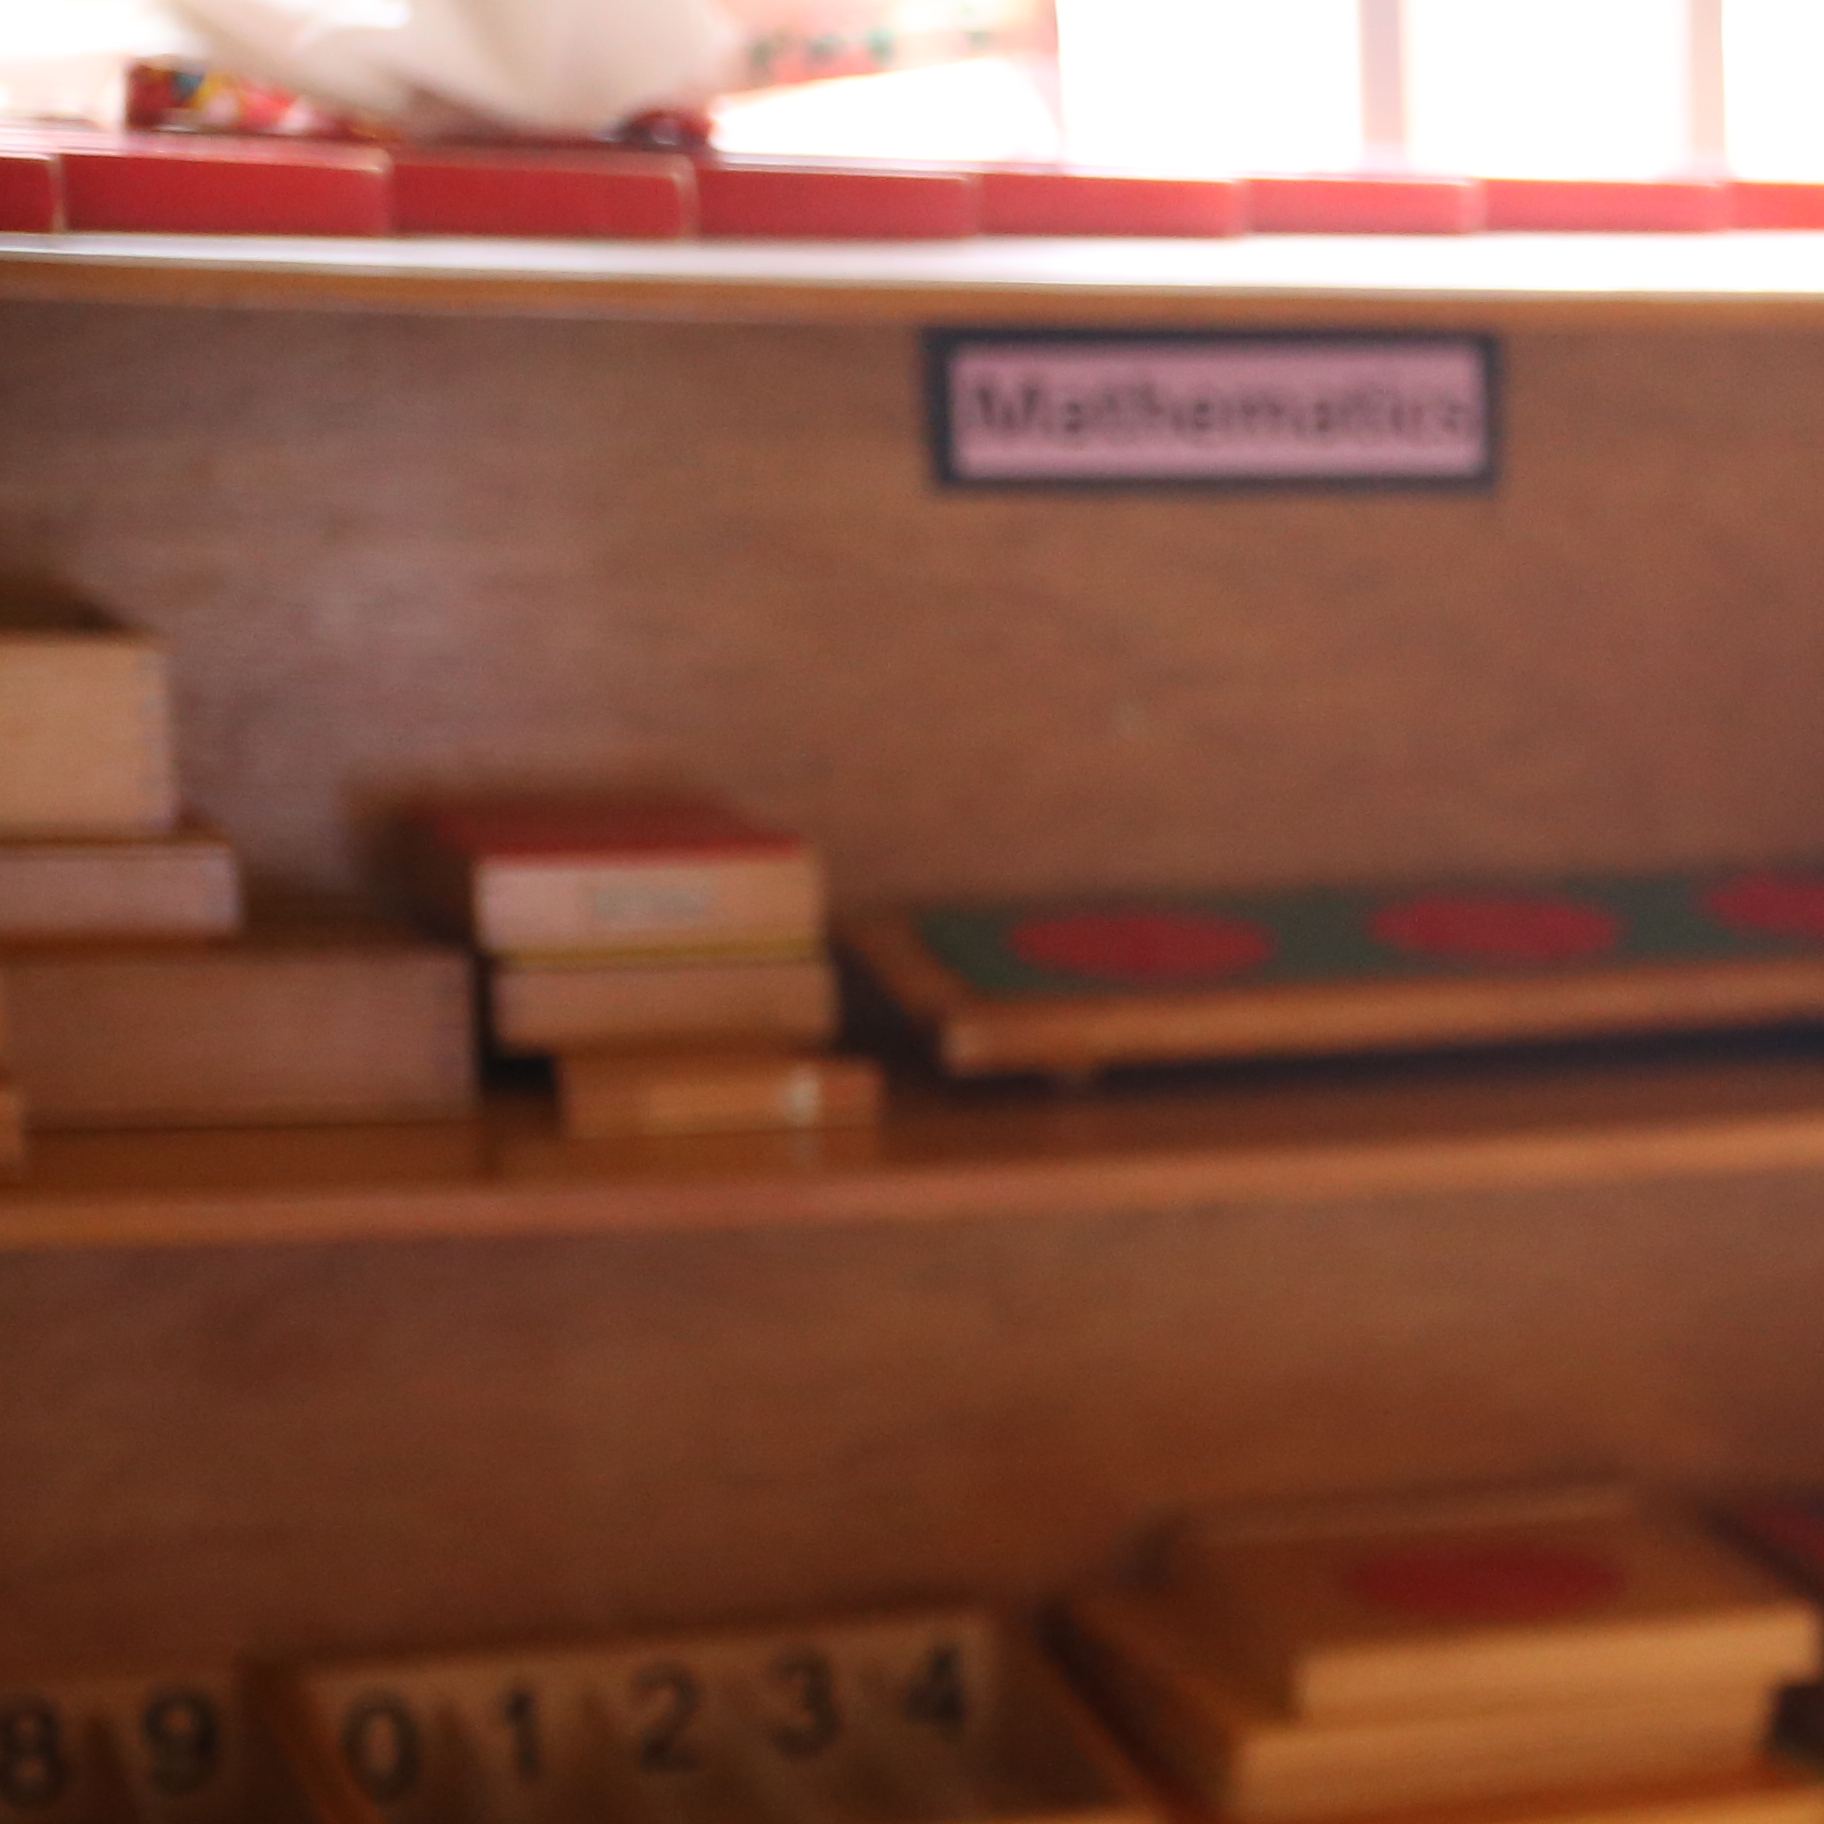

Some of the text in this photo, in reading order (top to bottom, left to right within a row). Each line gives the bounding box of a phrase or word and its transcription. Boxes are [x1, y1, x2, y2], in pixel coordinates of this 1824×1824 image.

[960, 374, 1480, 448] Mathematics
[0, 1684, 220, 1803] 8 9
[344, 1640, 968, 1800] 0 1 2 3 4
